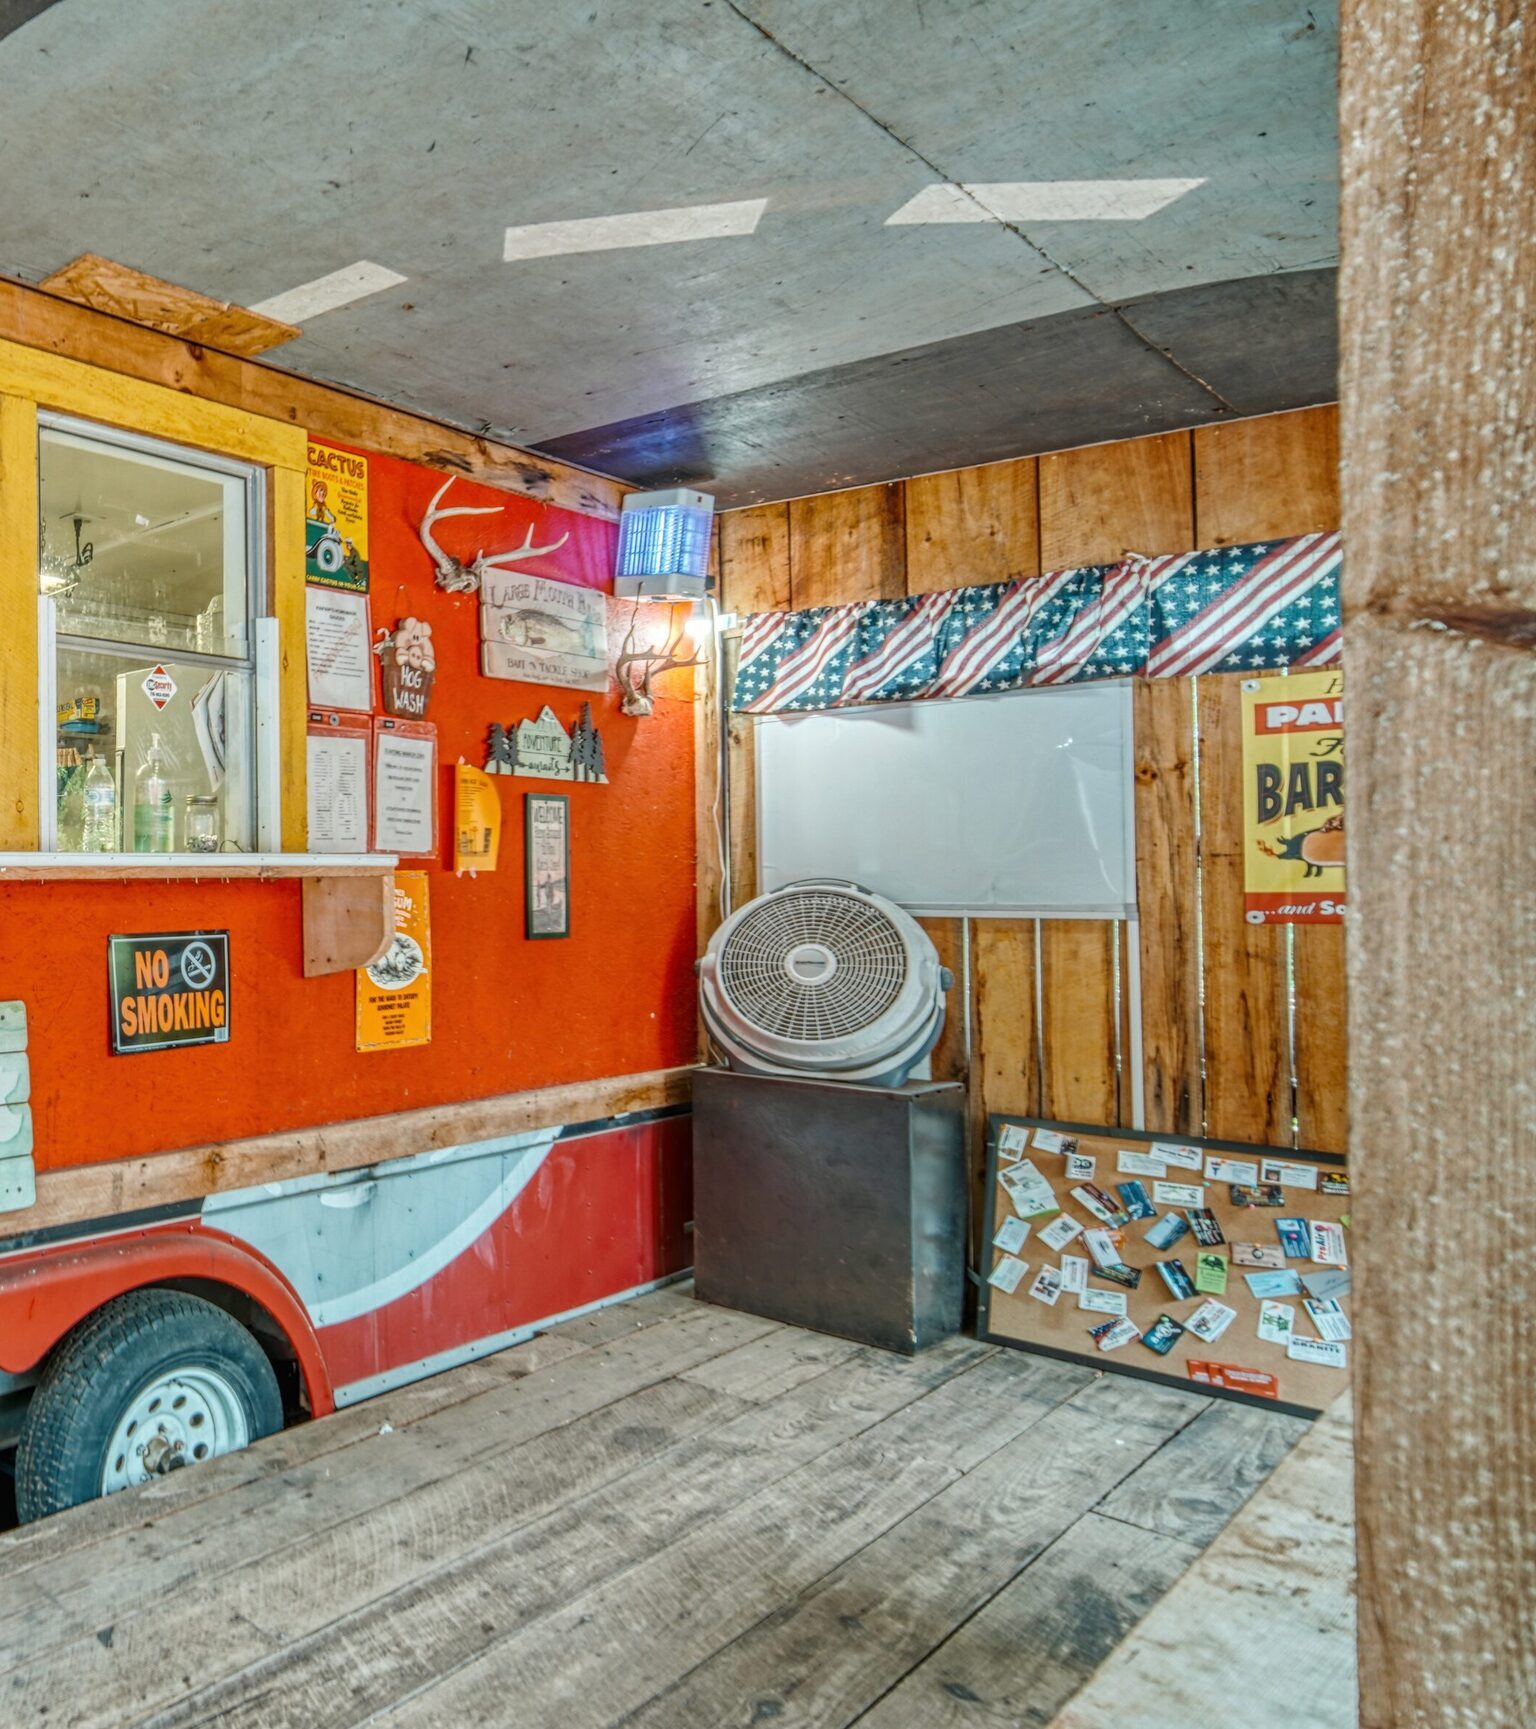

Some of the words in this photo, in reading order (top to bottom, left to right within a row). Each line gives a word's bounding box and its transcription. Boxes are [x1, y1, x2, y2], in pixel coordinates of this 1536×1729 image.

[307, 447, 364, 479] CACTUS
[490, 583, 530, 609] LARGE
[533, 580, 575, 609] MOUTH
[400, 665, 423, 689] HOG
[392, 687, 424, 715] WASH
[524, 733, 561, 753] ADVENTURE
[135, 949, 169, 989] NO
[121, 989, 224, 1036] SMOKING
